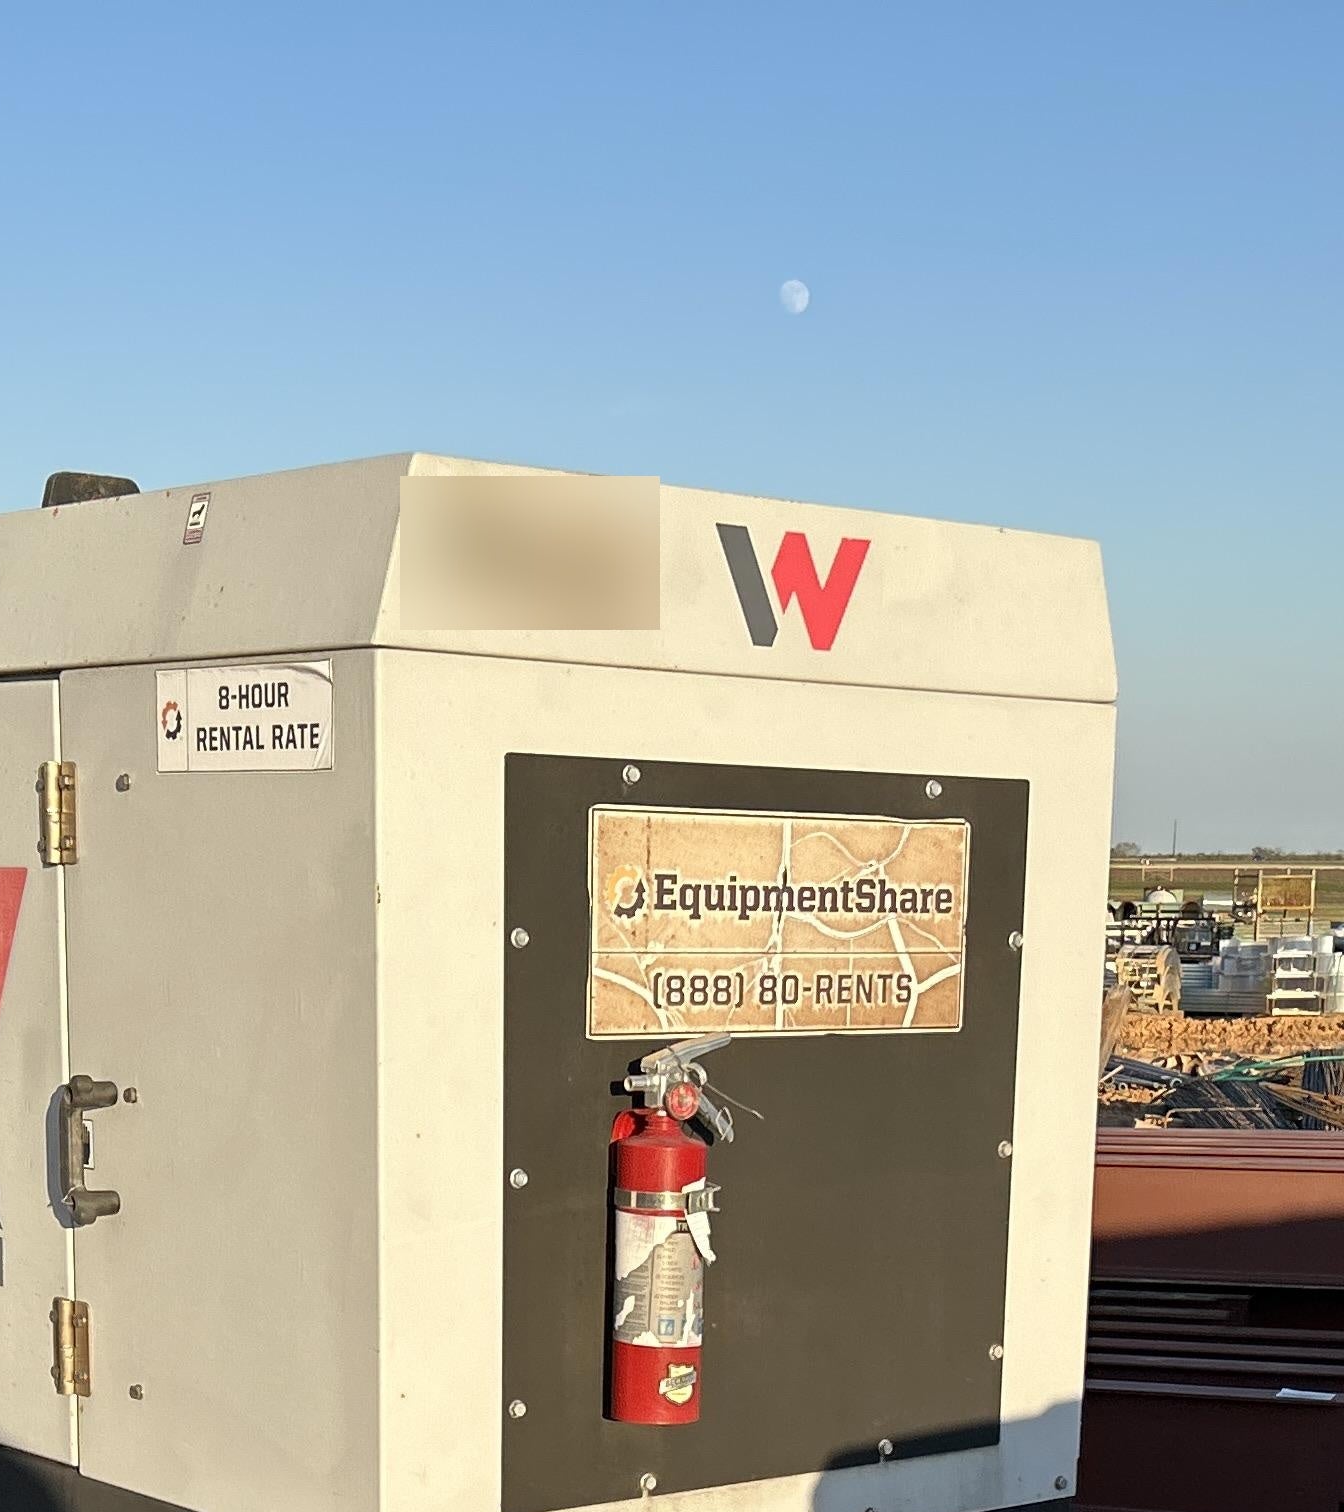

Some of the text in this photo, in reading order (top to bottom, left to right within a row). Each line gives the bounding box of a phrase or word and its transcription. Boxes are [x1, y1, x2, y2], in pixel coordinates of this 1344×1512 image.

[218, 682, 289, 711] 8-HOUR
[196, 723, 320, 751] RENTAL RATE
[654, 873, 953, 920] EquipmentShare
[653, 972, 913, 1008] (888) 80-RENTS
